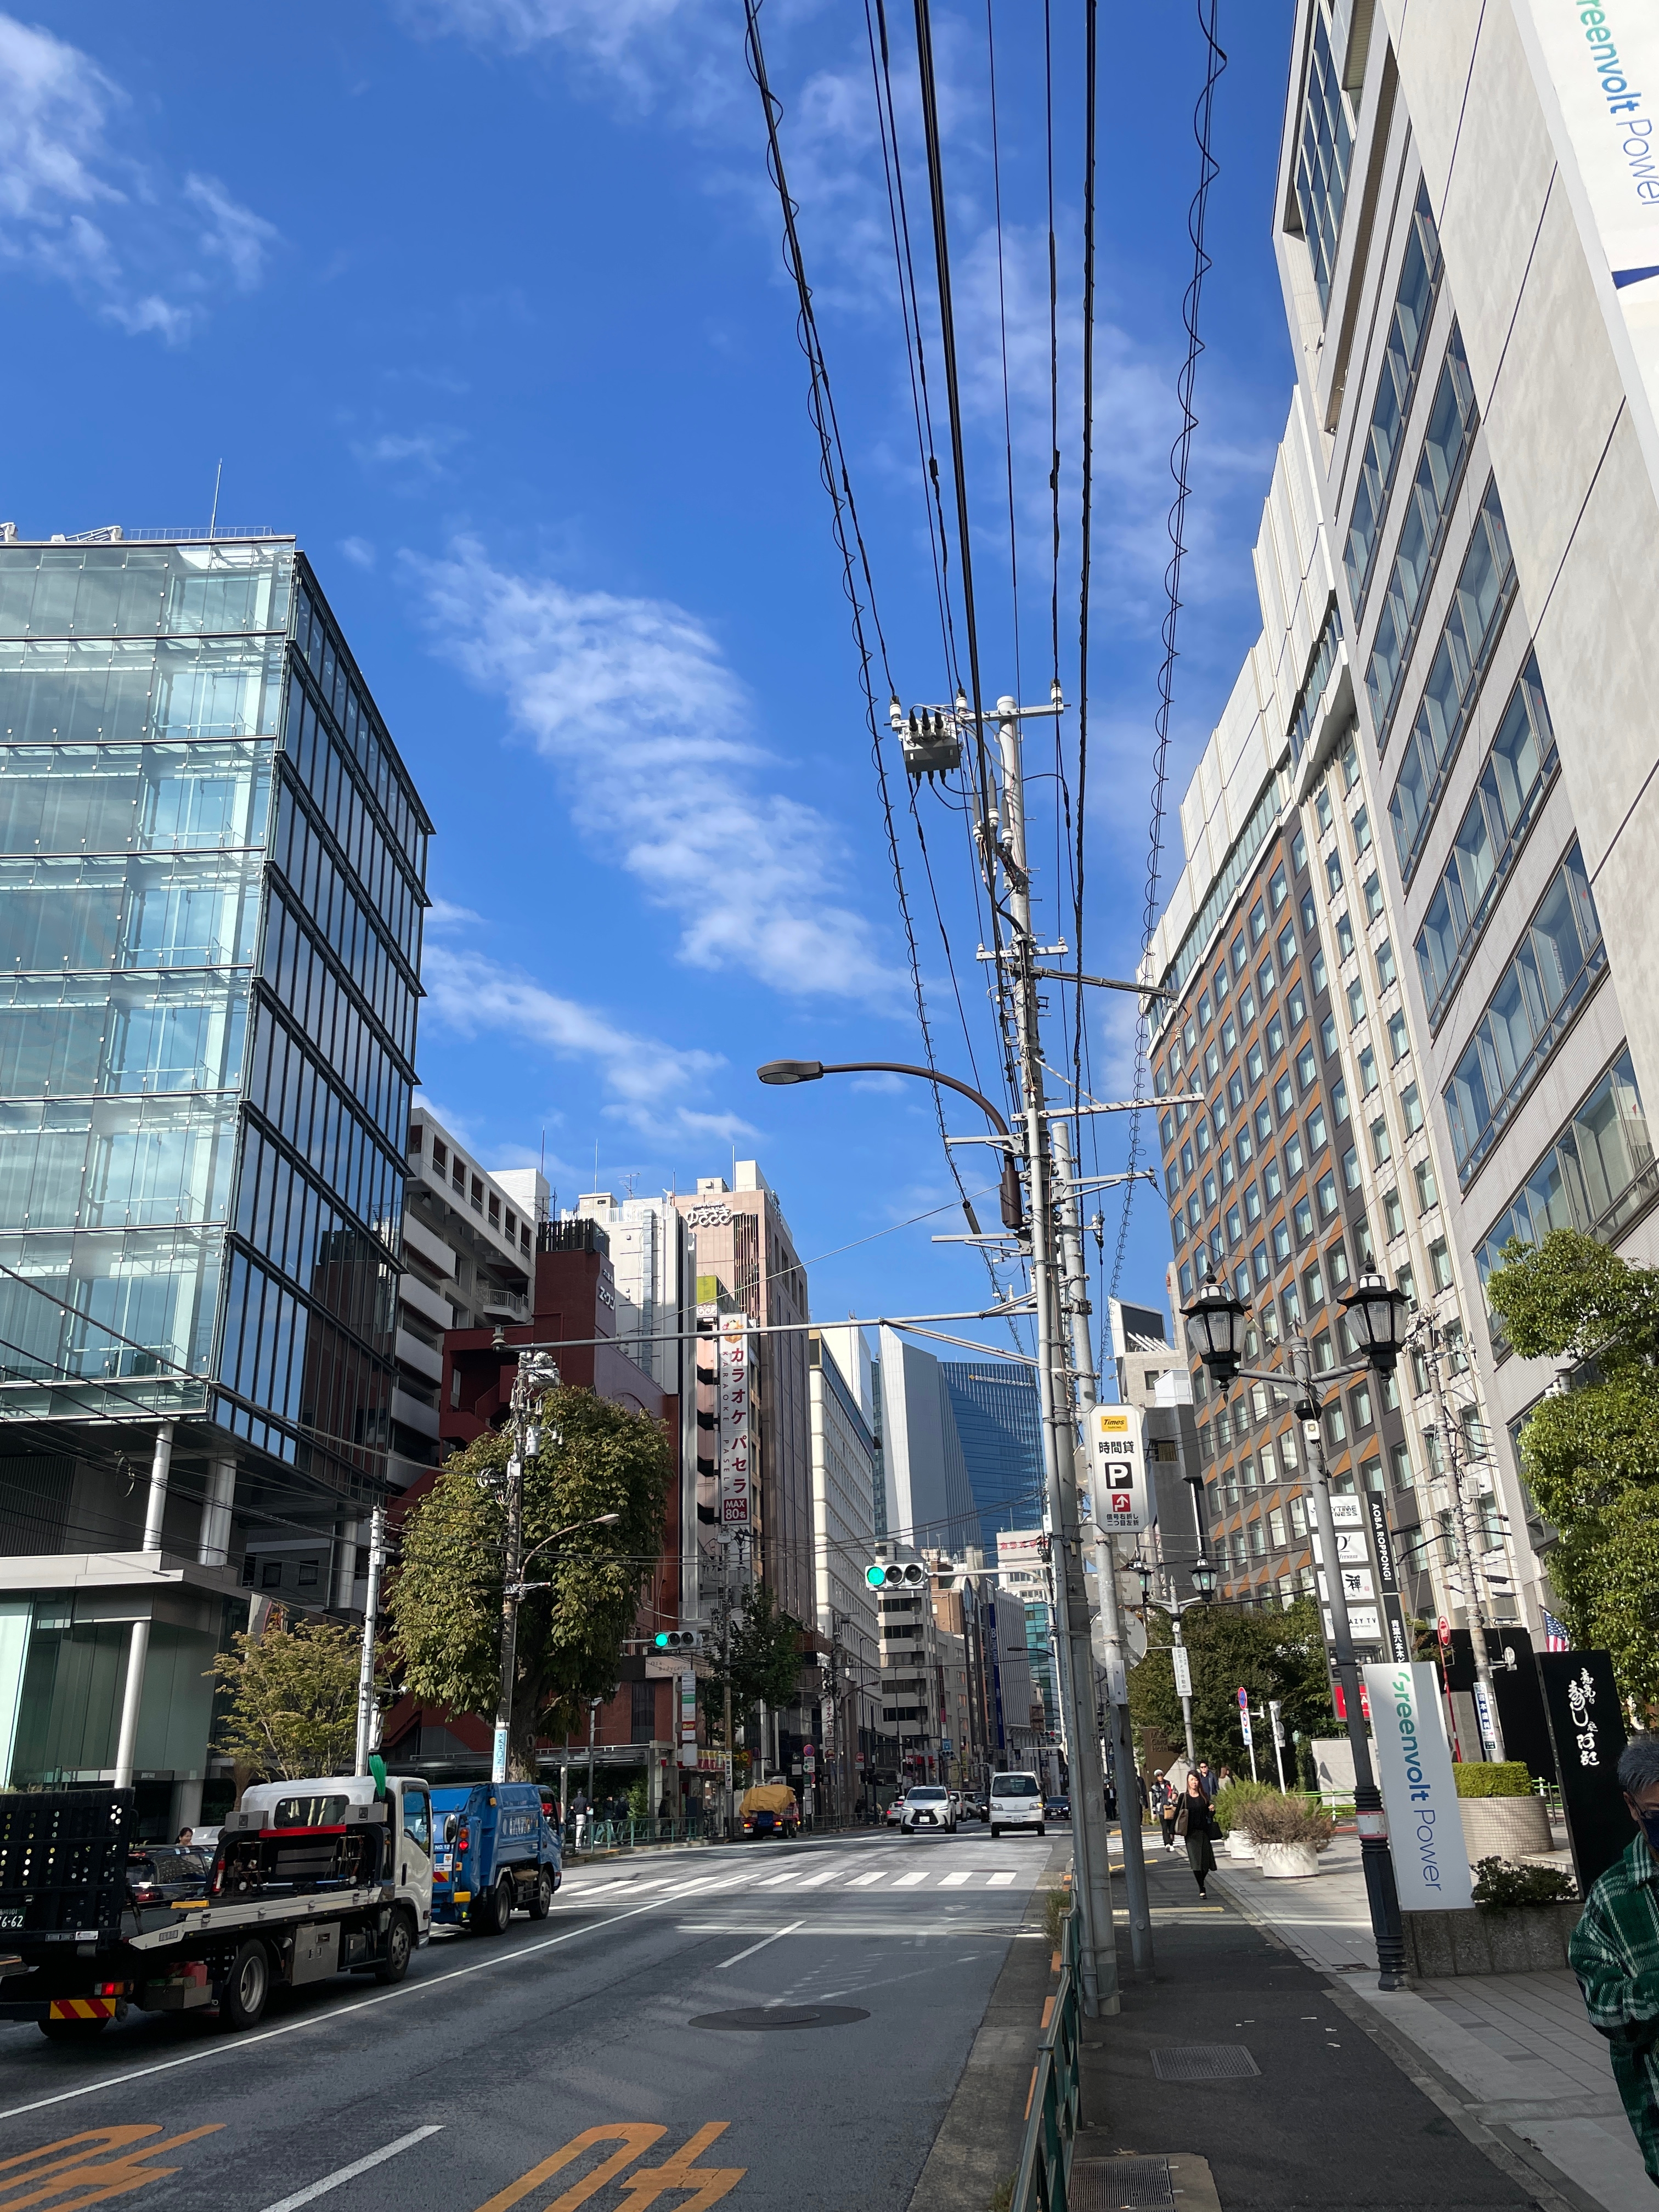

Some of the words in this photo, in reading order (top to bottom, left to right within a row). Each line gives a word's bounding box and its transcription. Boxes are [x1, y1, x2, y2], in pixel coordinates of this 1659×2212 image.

[1576, 0, 1641, 114] reenvolt
[731, 1347, 746, 1424] カラオケ
[1098, 1440, 1135, 1454] 時間貸
[731, 1435, 747, 1493] パセラ
[1108, 1464, 1128, 1487] P
[725, 1499, 744, 1508] MAX
[725, 1508, 746, 1520] 80名
[1372, 1503, 1383, 1530] AOBA
[1376, 1531, 1392, 1581] ROPPONGI
[1392, 1672, 1431, 1802] Greenvolt
[1414, 1810, 1442, 1891] Power
[0, 1916, 23, 1927] 6-62
